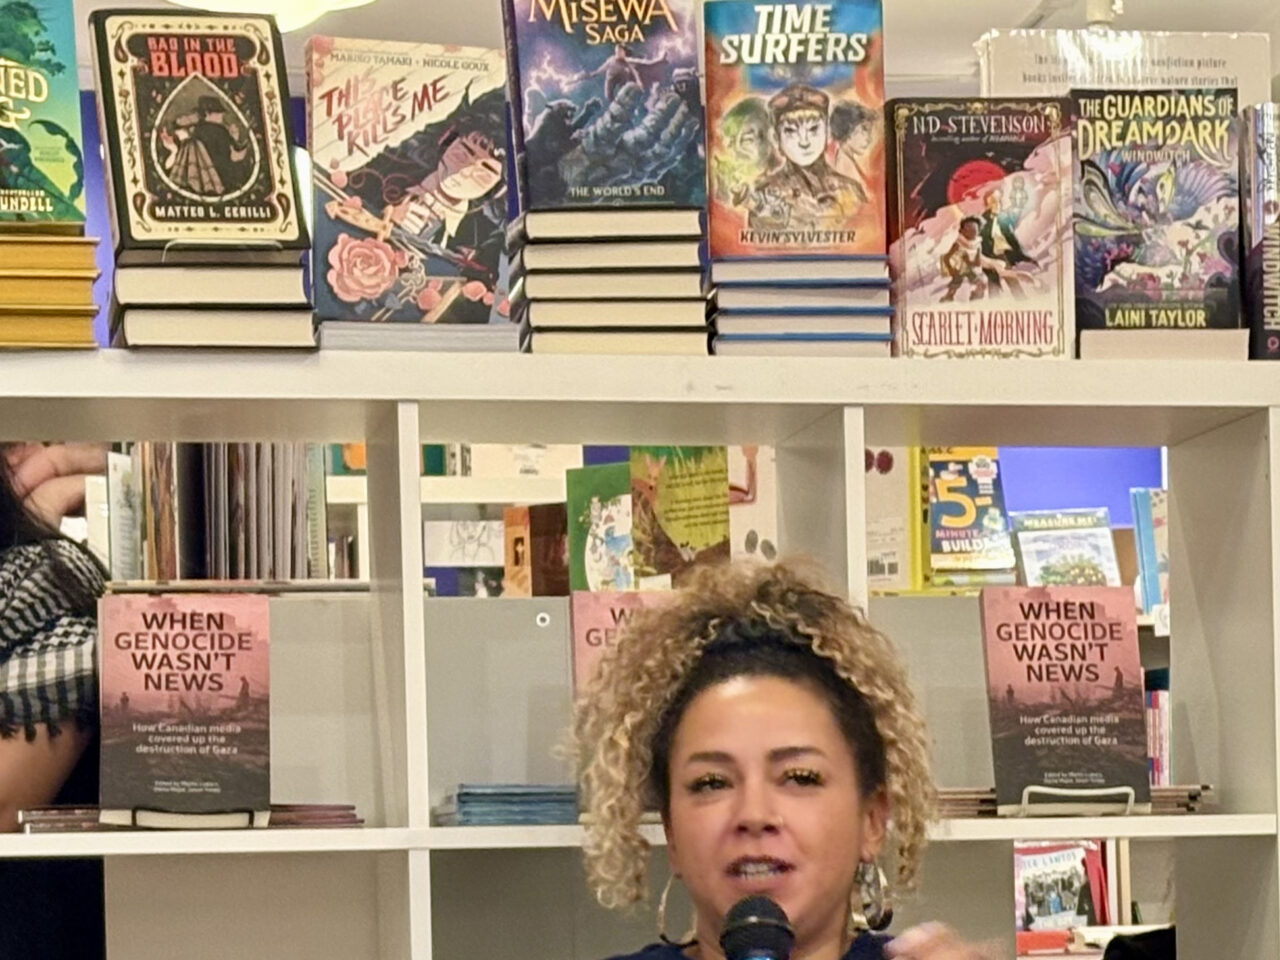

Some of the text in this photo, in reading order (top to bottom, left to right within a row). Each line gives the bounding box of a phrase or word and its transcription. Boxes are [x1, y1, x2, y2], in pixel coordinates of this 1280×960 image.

[528, 0, 679, 34] MISEWA
[753, 3, 834, 34] TIME
[585, 23, 645, 46] SAGA
[184, 38, 200, 51] IN
[206, 38, 236, 52] THE
[719, 34, 868, 65] SURFERS
[150, 51, 239, 78] BLOOD
[423, 58, 459, 70] NICOLE
[411, 74, 450, 121] ME
[1078, 94, 1234, 121] THE GUARDIANS OF
[947, 114, 1046, 134] STEVENSON
[1076, 118, 1234, 169] DREAMDARK
[1121, 150, 1191, 163] WINDWITCH
[570, 185, 665, 197] THE WORLD'S END
[154, 206, 205, 218] MATTEO
[740, 229, 857, 244] KEVIN SYLVESTER
[912, 308, 1054, 347] SCARLET MORNING
[1105, 308, 1207, 328] LAINI TAYLOR
[1018, 602, 1096, 621] WHEN
[142, 612, 224, 631] WHEN
[996, 621, 1124, 642] GENOCIDE
[114, 631, 253, 652] GENOCIDE
[130, 652, 236, 672] WASN'T
[1012, 643, 1109, 662] WASN'T
[143, 673, 224, 692] NEWS
[1026, 664, 1100, 683] NEWS
[133, 722, 242, 733] How Canadian media
[1020, 714, 1120, 724] How Canadian media
[148, 735, 226, 745] covered up the
[1035, 725, 1106, 736] covered up the
[136, 744, 239, 755] destruction of Gaza
[1024, 736, 1080, 746] destruction
[1082, 736, 1092, 745] of
